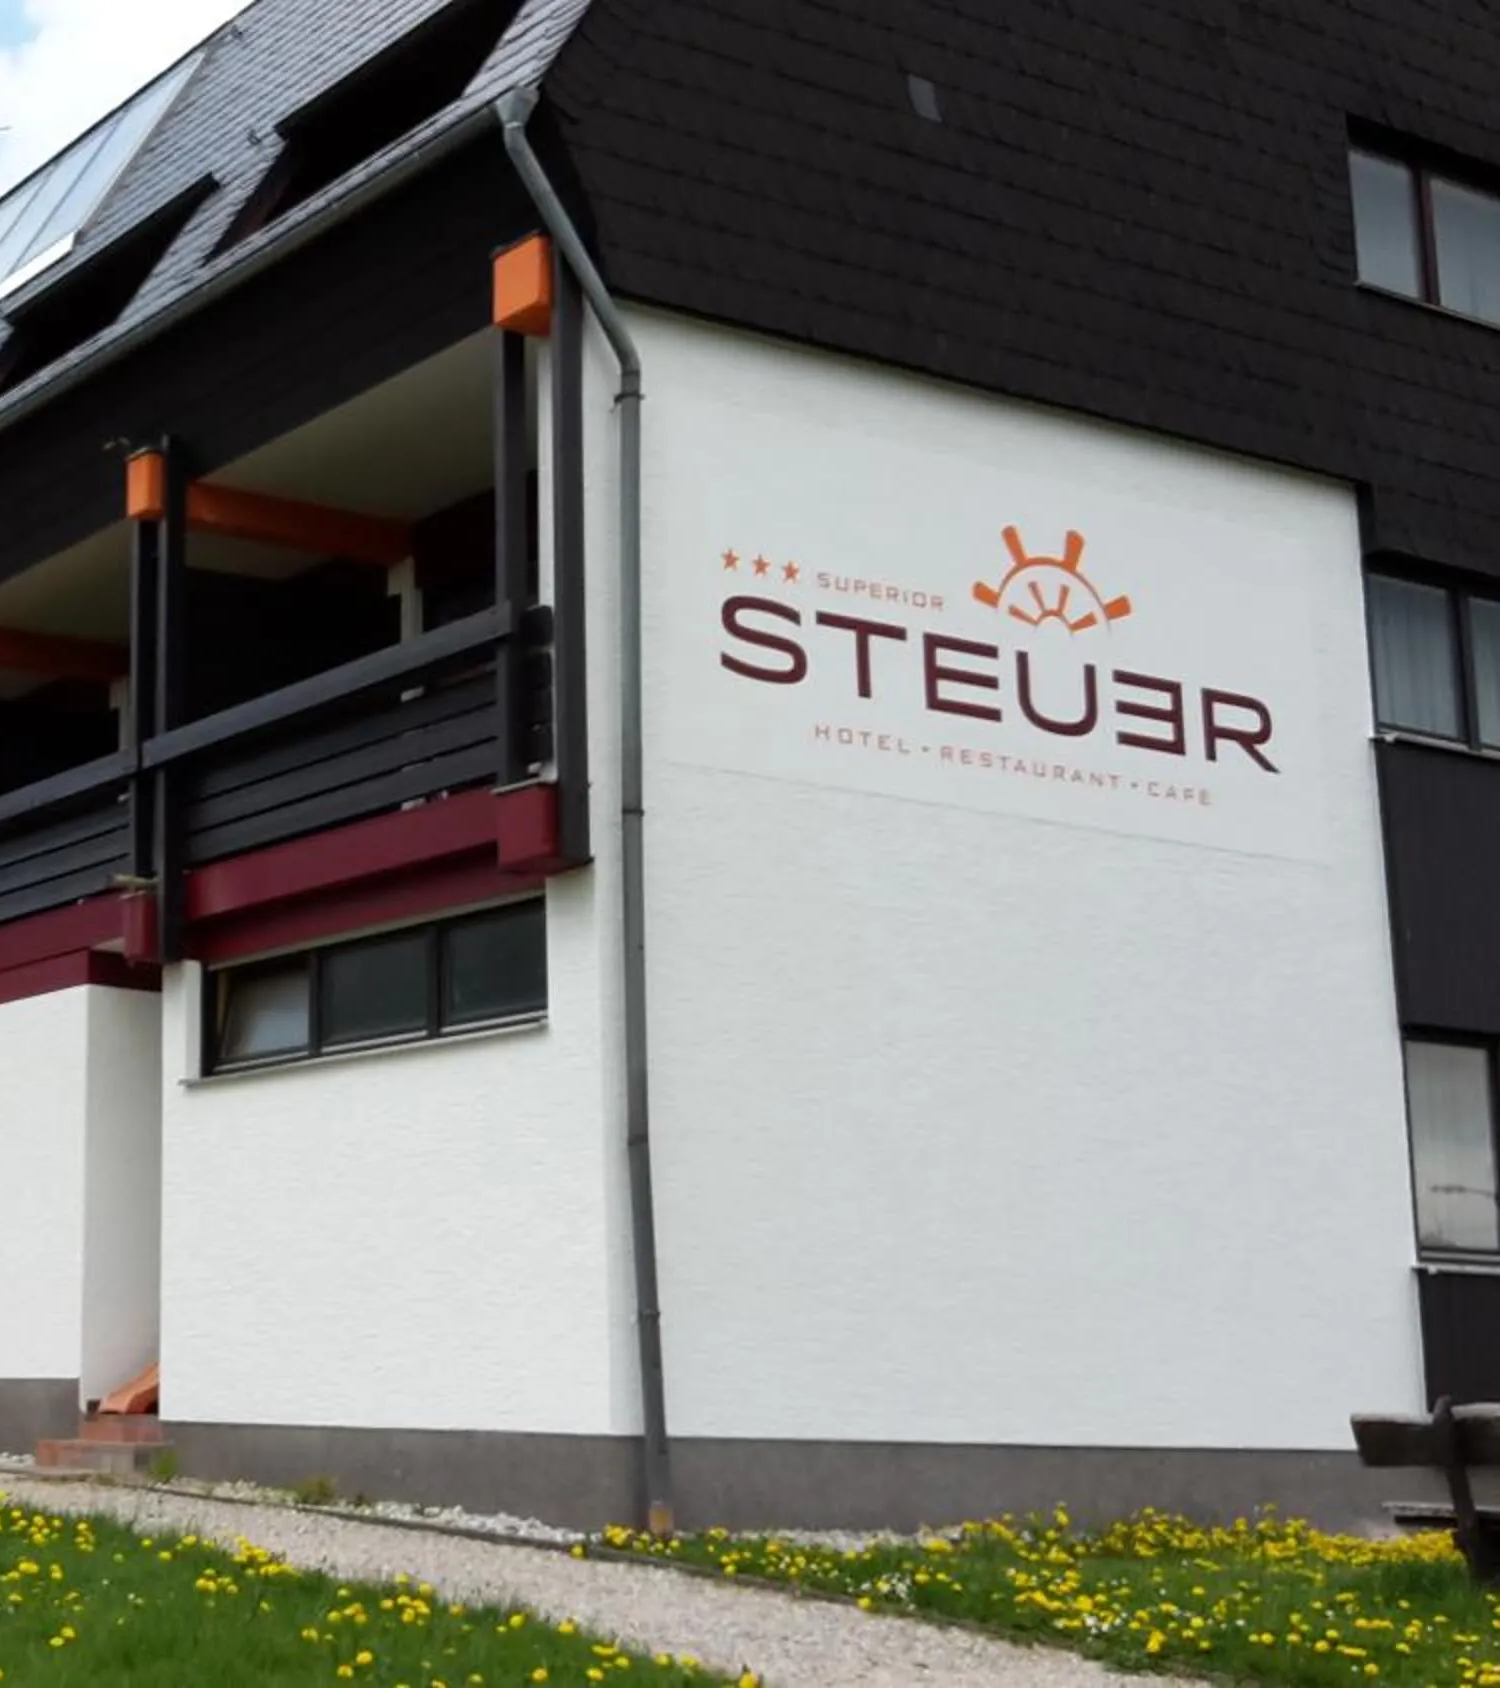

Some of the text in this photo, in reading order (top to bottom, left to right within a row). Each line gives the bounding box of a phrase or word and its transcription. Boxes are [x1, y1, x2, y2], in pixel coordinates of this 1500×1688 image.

[816, 572, 944, 611] SUPERIOR
[720, 595, 1280, 774] STEUER
[815, 725, 911, 755] HOTEL
[940, 745, 1121, 788] RESTAURANT
